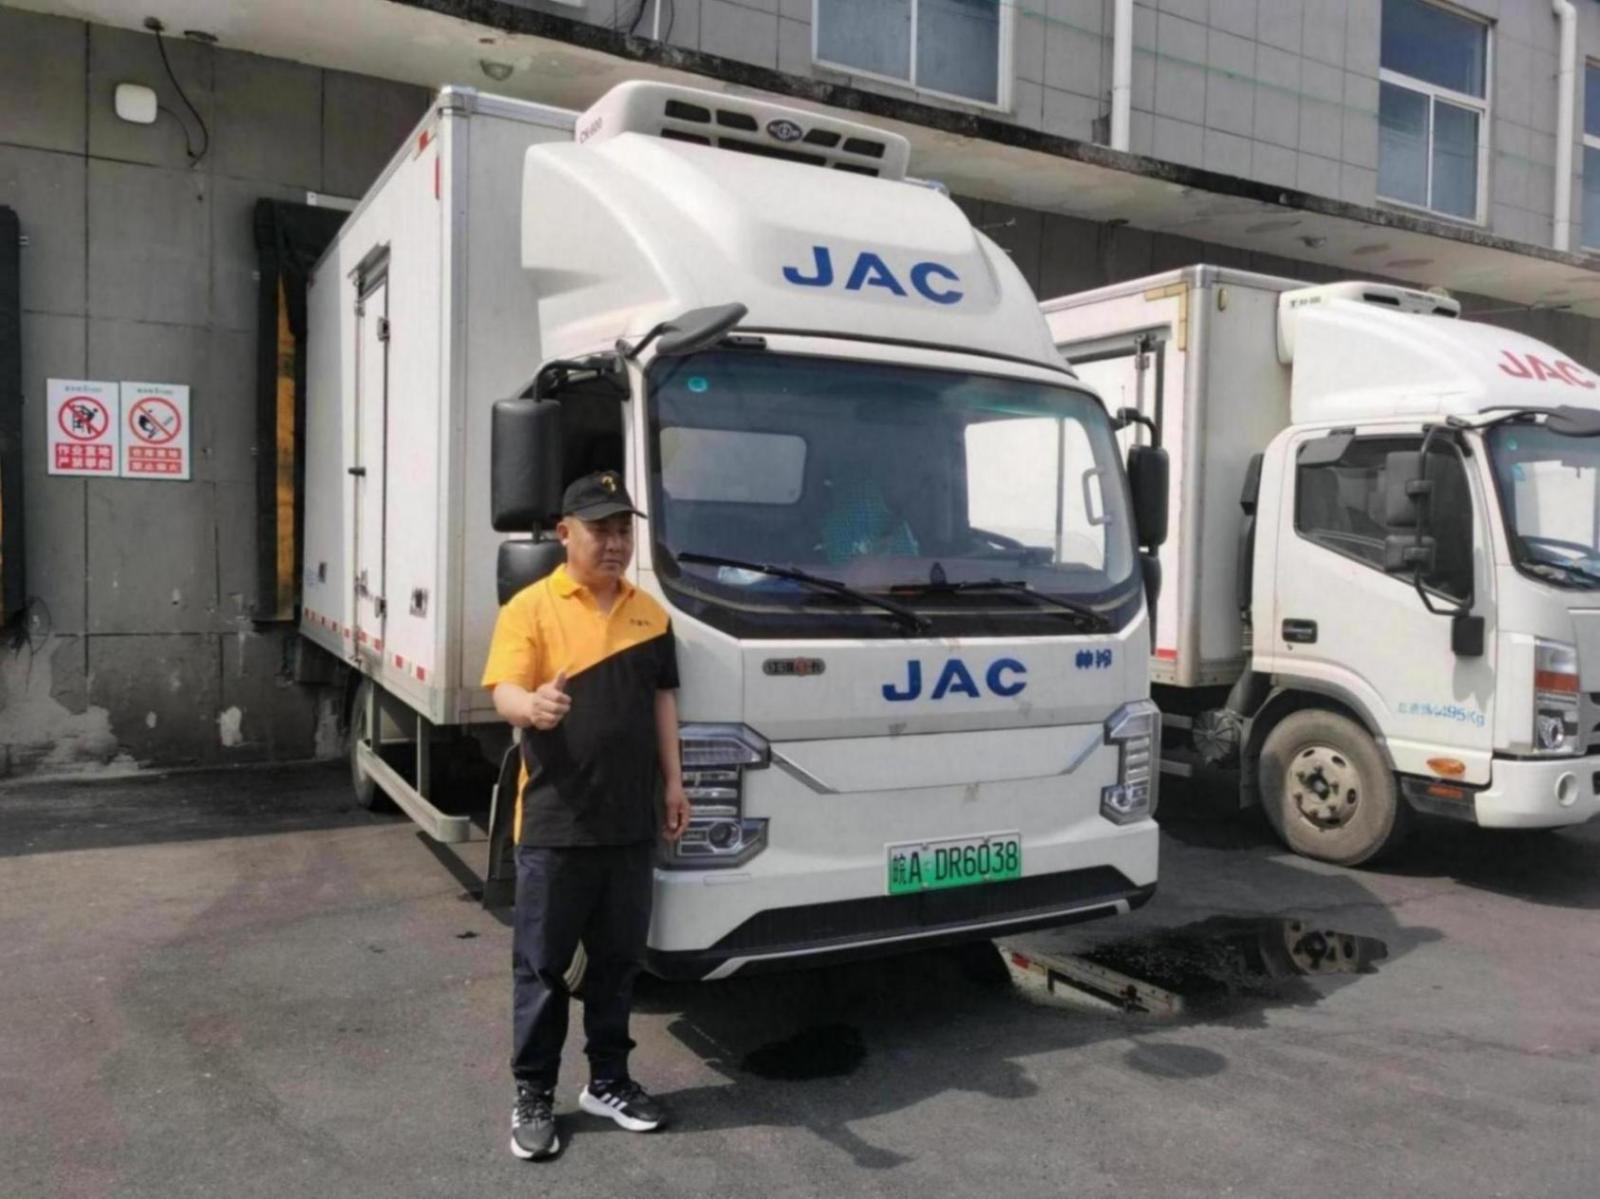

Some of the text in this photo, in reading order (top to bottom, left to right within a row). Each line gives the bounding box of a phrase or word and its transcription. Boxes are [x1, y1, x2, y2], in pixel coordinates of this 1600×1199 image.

[782, 246, 964, 305] JAC
[1498, 350, 1597, 389] JAC
[882, 658, 1027, 702] JAC
